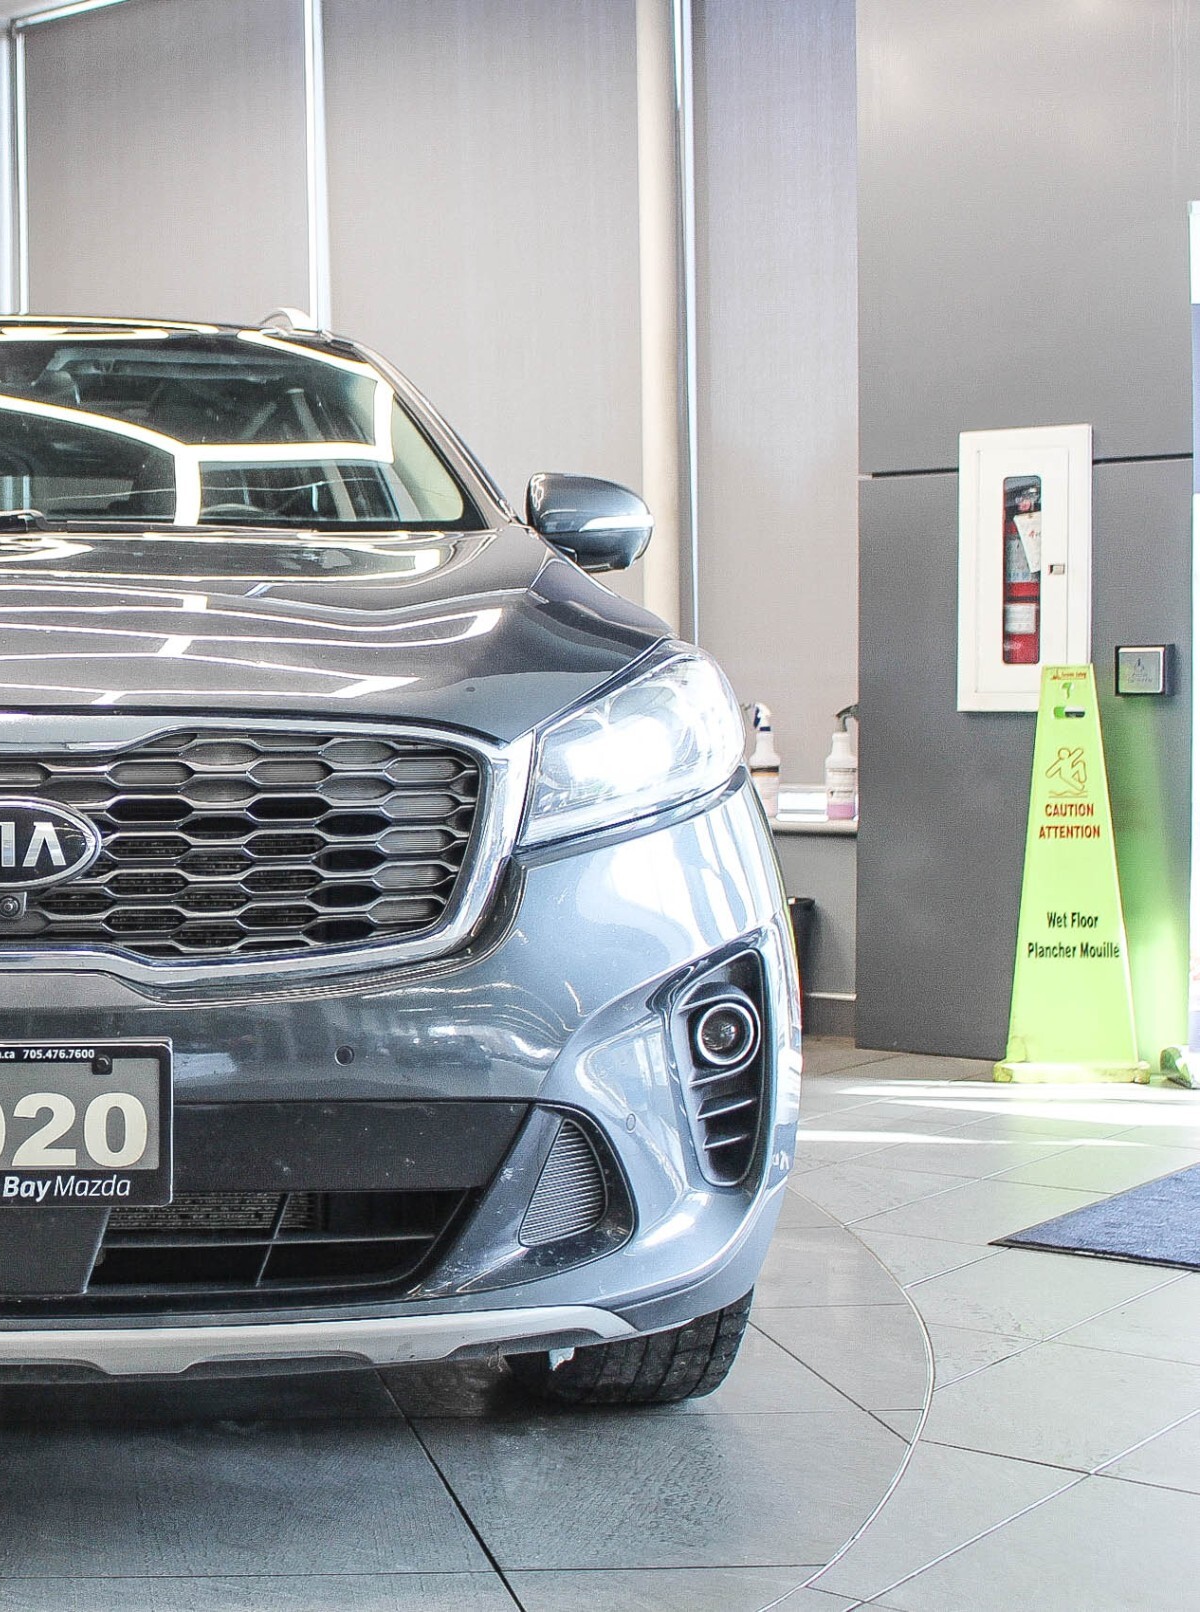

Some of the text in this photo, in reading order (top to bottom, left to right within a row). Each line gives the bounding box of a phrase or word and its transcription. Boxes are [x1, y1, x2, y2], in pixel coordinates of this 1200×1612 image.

[1044, 803, 1094, 817] CAUTION
[1038, 825, 1100, 839] ATTENTION
[1047, 912, 1099, 928] Wet Floor
[1027, 942, 1077, 958] Plancher
[23, 1048, 95, 1059] 705.476.7600
[3, 1176, 52, 1202] Bay
[53, 1174, 131, 1197] Mazda
